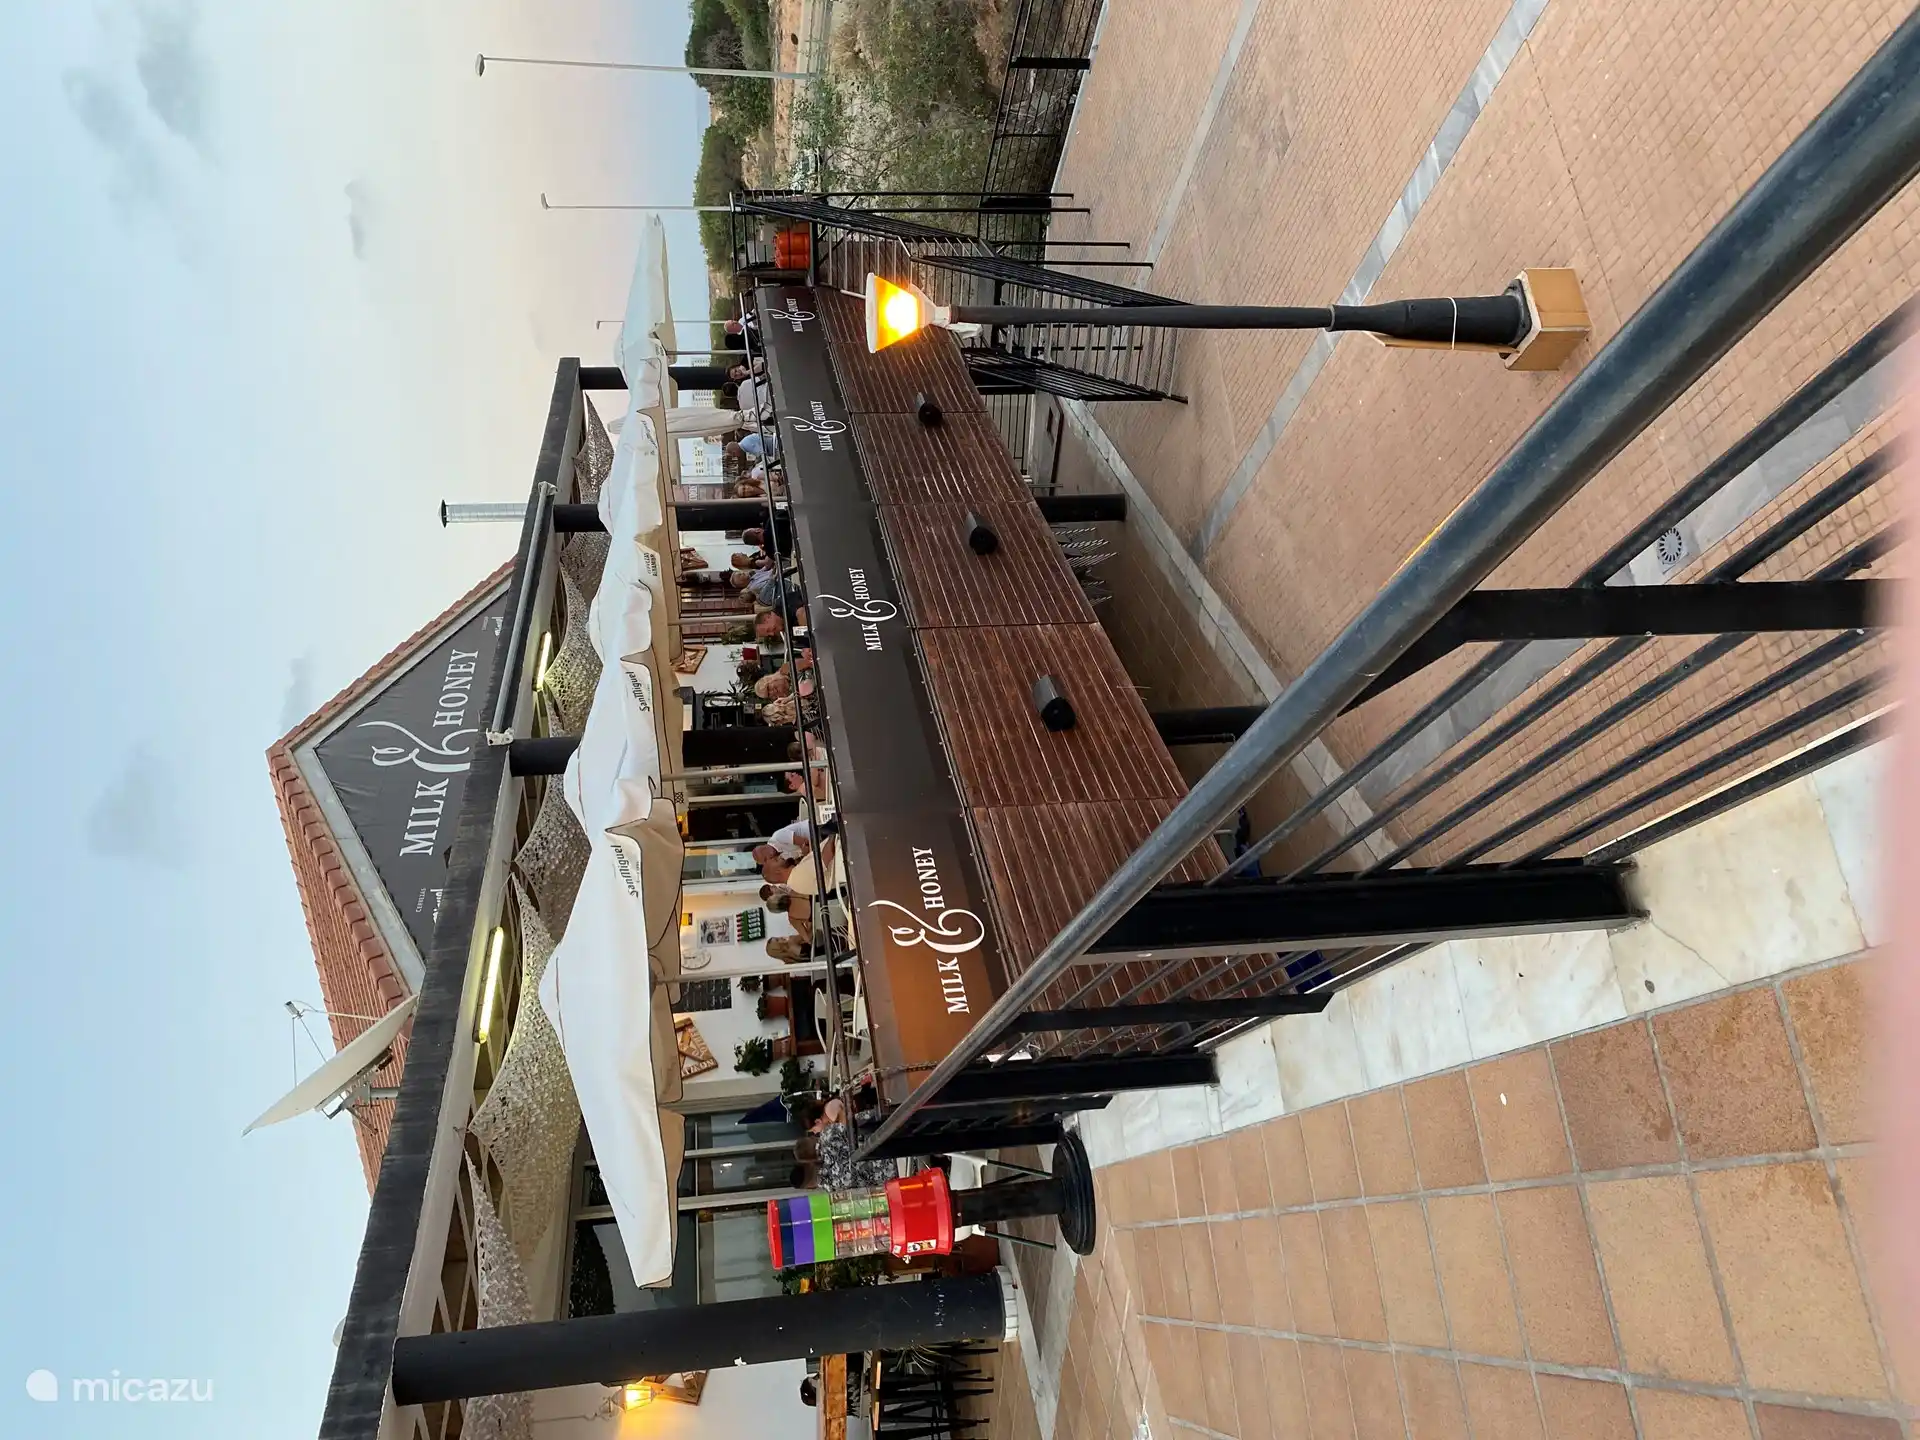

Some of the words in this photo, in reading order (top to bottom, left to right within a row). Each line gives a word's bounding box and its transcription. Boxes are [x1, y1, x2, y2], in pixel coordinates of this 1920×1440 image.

[784, 416, 846, 434] &
[810, 401, 825, 420] HONEY
[817, 434, 833, 451] MILK
[848, 567, 871, 601] HONEY
[813, 594, 897, 622] &
[861, 622, 883, 651] MILK
[432, 648, 478, 728] HONEY
[357, 720, 478, 773] &
[399, 777, 449, 857] MILK
[911, 846, 946, 910] HONEY
[867, 899, 985, 954] &
[936, 956, 971, 1015] MILK
